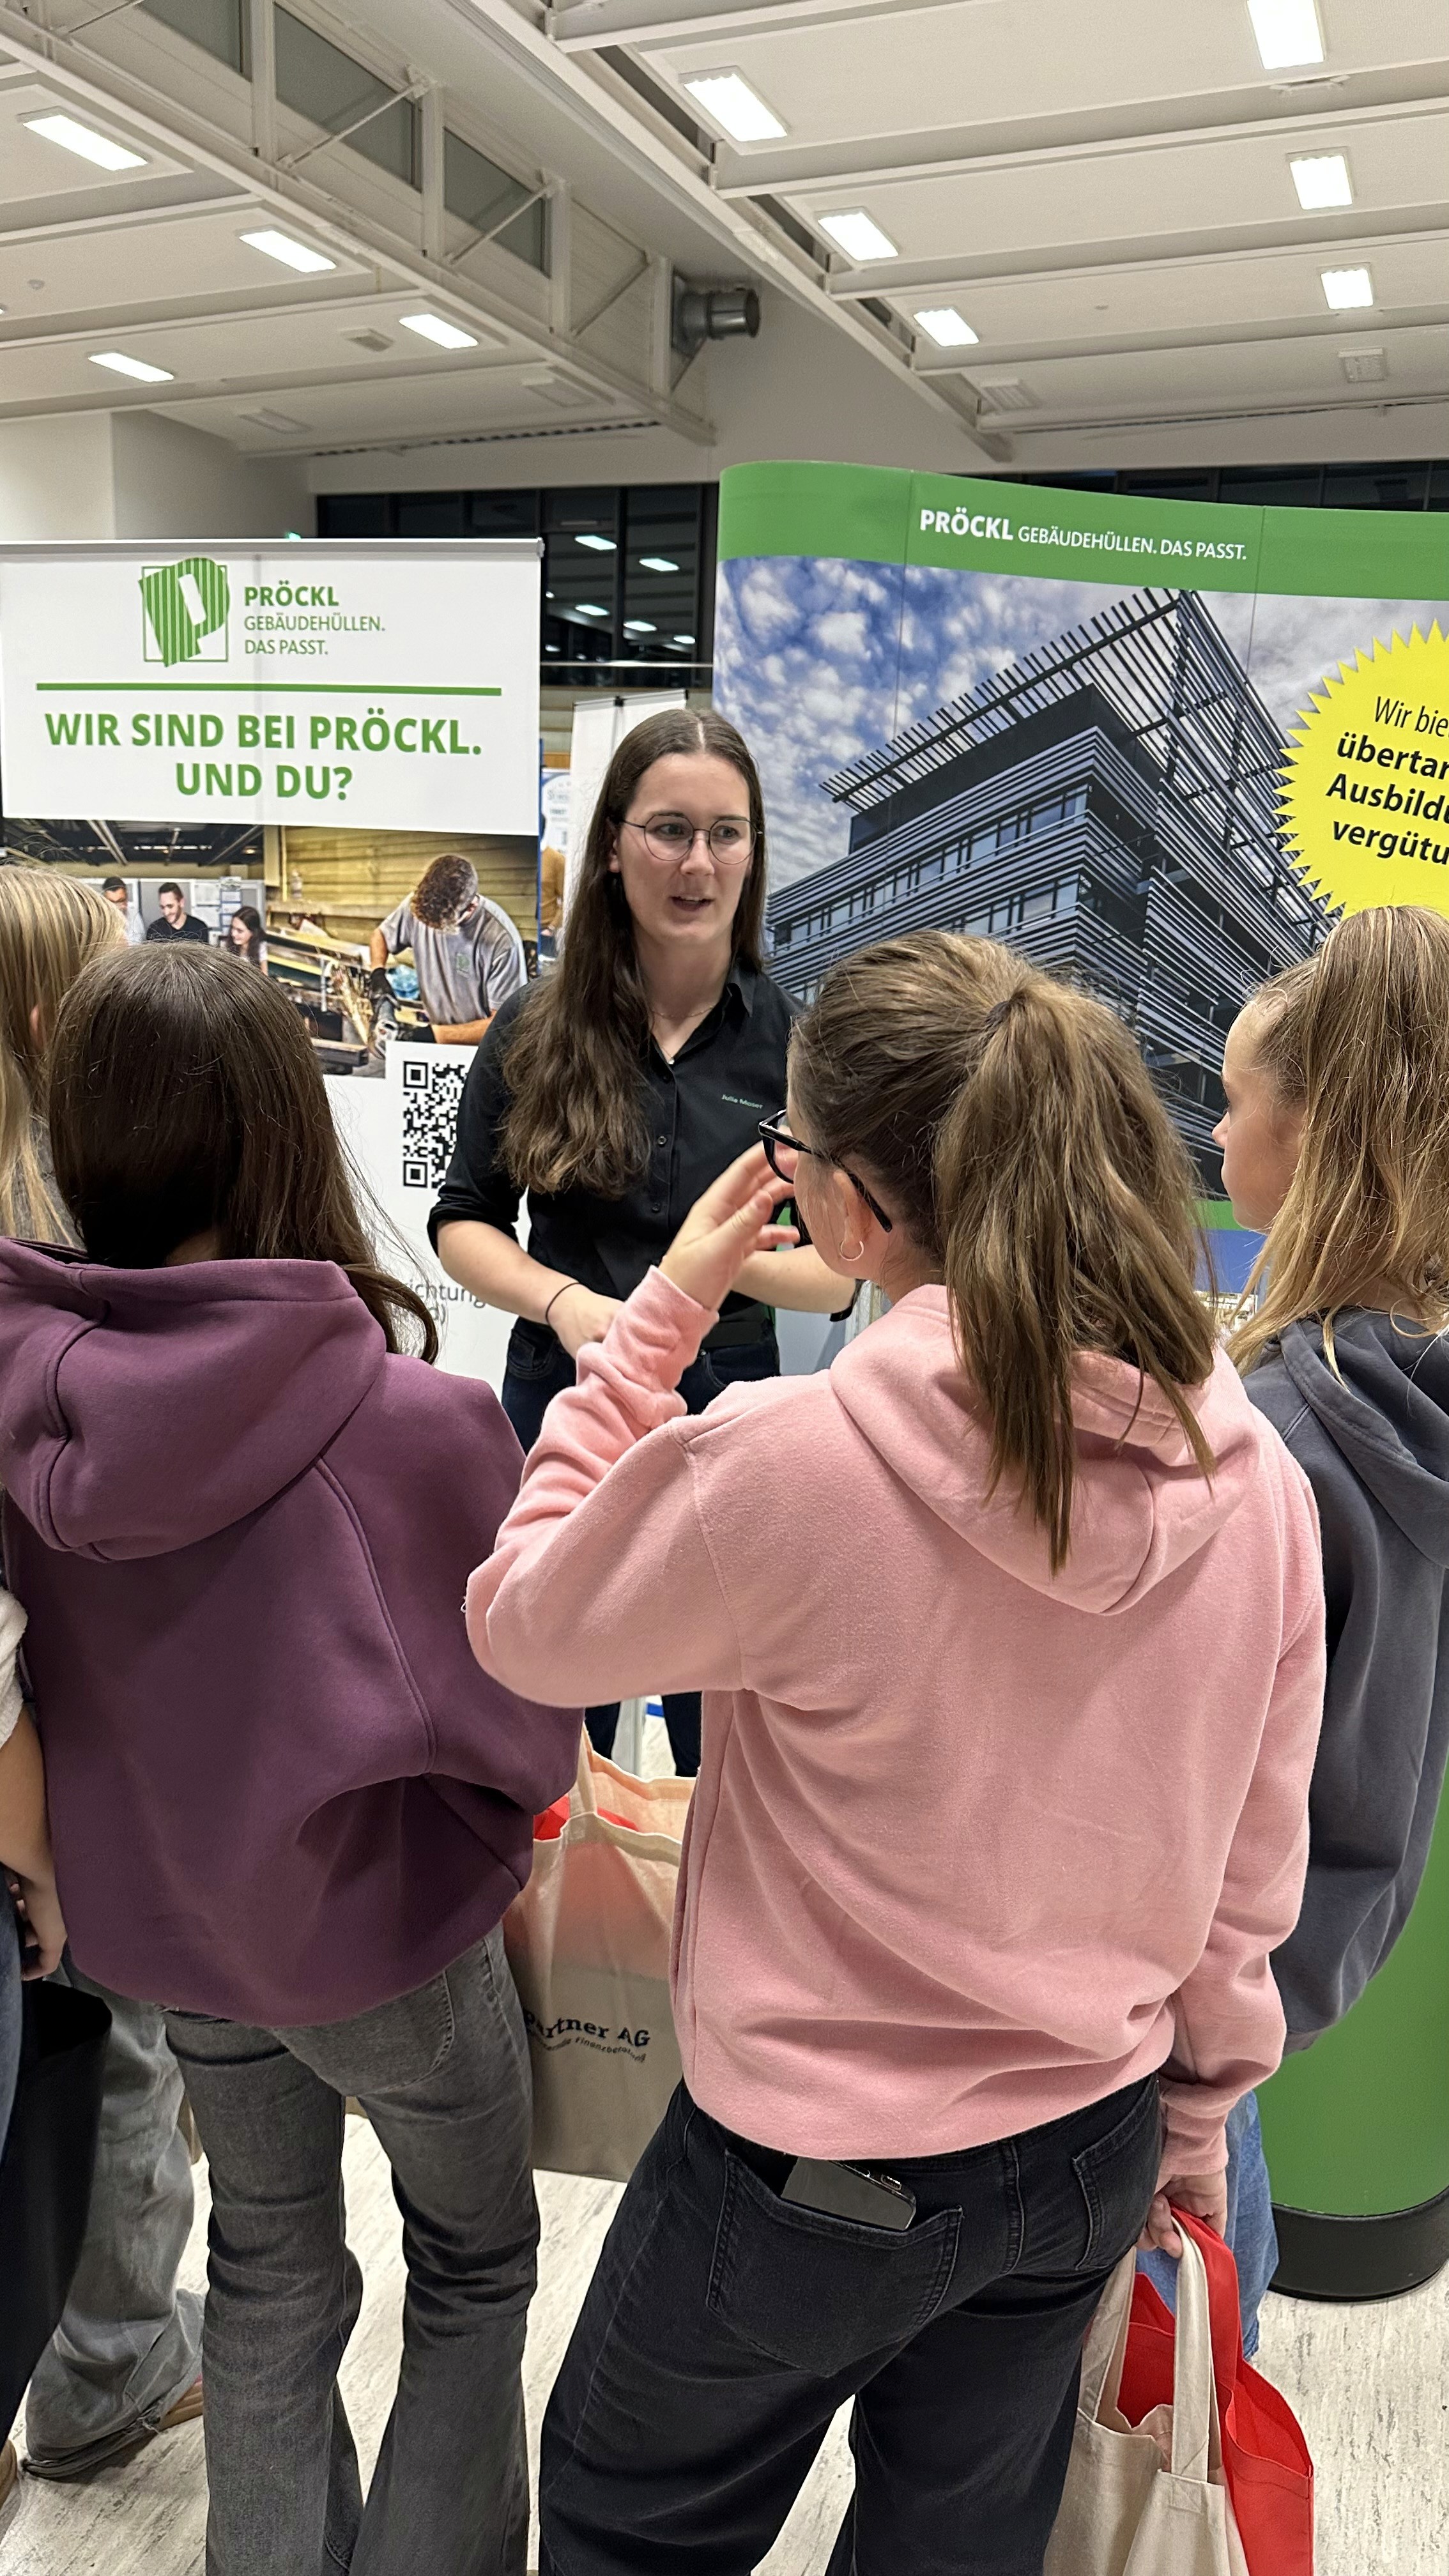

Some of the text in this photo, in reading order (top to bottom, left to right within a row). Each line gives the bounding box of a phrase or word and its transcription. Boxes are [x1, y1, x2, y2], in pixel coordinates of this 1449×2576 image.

[920, 507, 1247, 560] PRÖCKL GEBÄUDEHÜLLEN. DAS PASST.
[245, 580, 339, 606] PRÖCKL
[244, 612, 385, 631] GEBÄUDEHÜLLEN.
[245, 640, 329, 656] DAS PASST.
[45, 707, 482, 755] WIR SIND BEI PRÖCKL.
[1374, 696, 1449, 738] Wir bie
[176, 763, 353, 801] UND DU?
[617, 2026, 650, 2047] AG
